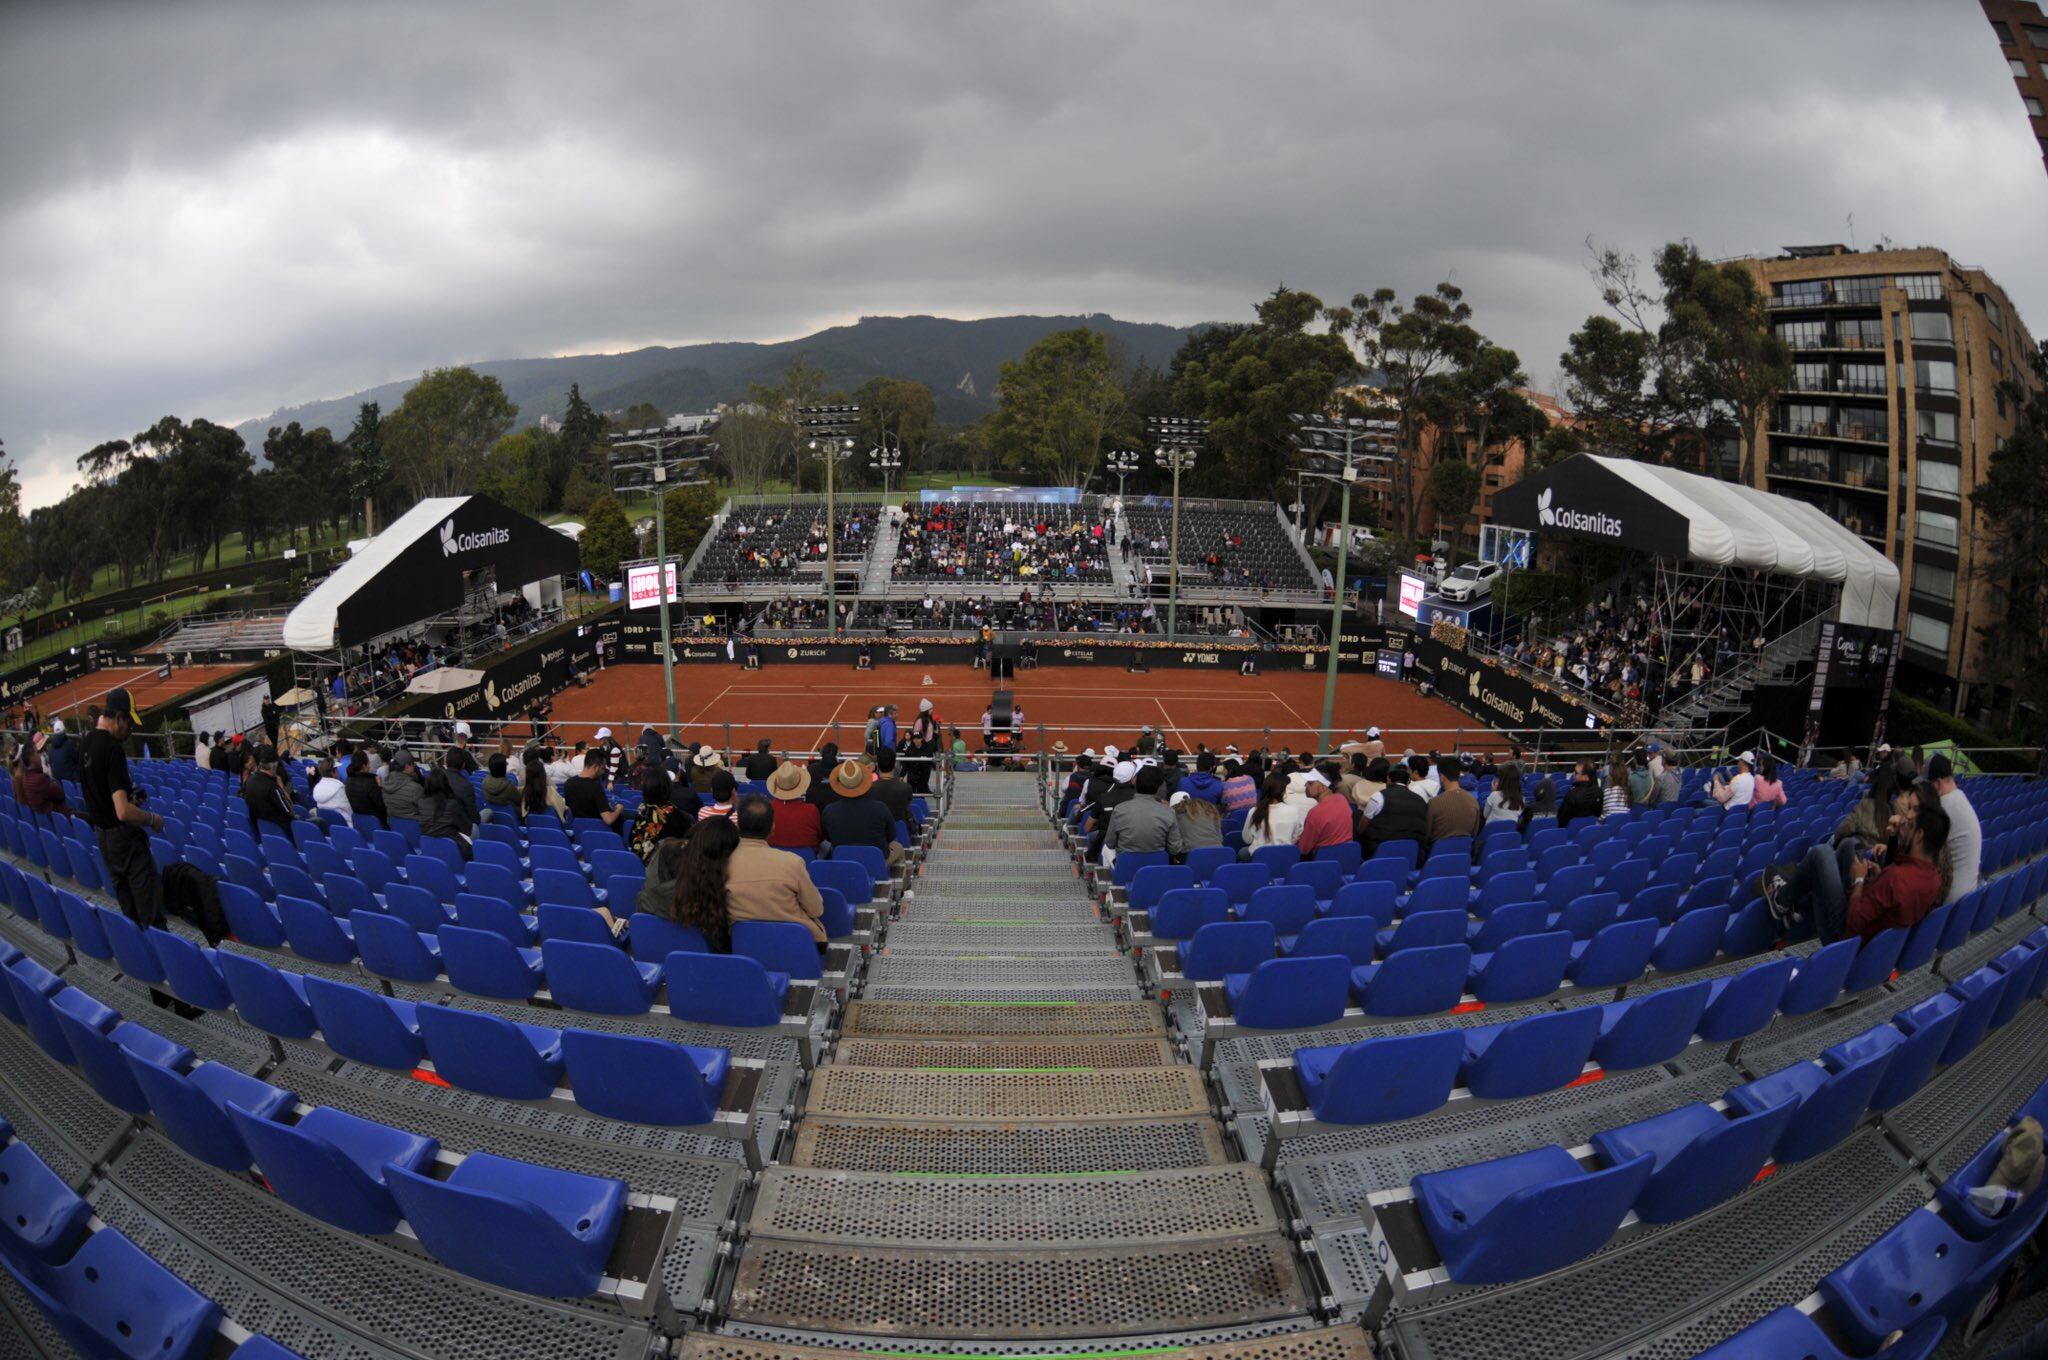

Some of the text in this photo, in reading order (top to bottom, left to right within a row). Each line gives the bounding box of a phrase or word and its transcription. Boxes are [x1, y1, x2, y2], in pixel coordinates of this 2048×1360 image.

[1556, 507, 1622, 537] Colsanitas
[458, 527, 509, 552] Colsanitas
[1197, 653, 1219, 664] YONEX
[456, 691, 480, 711] ZURICH
[501, 672, 542, 703] Colsanitas
[1481, 688, 1525, 723] Colsanitas
